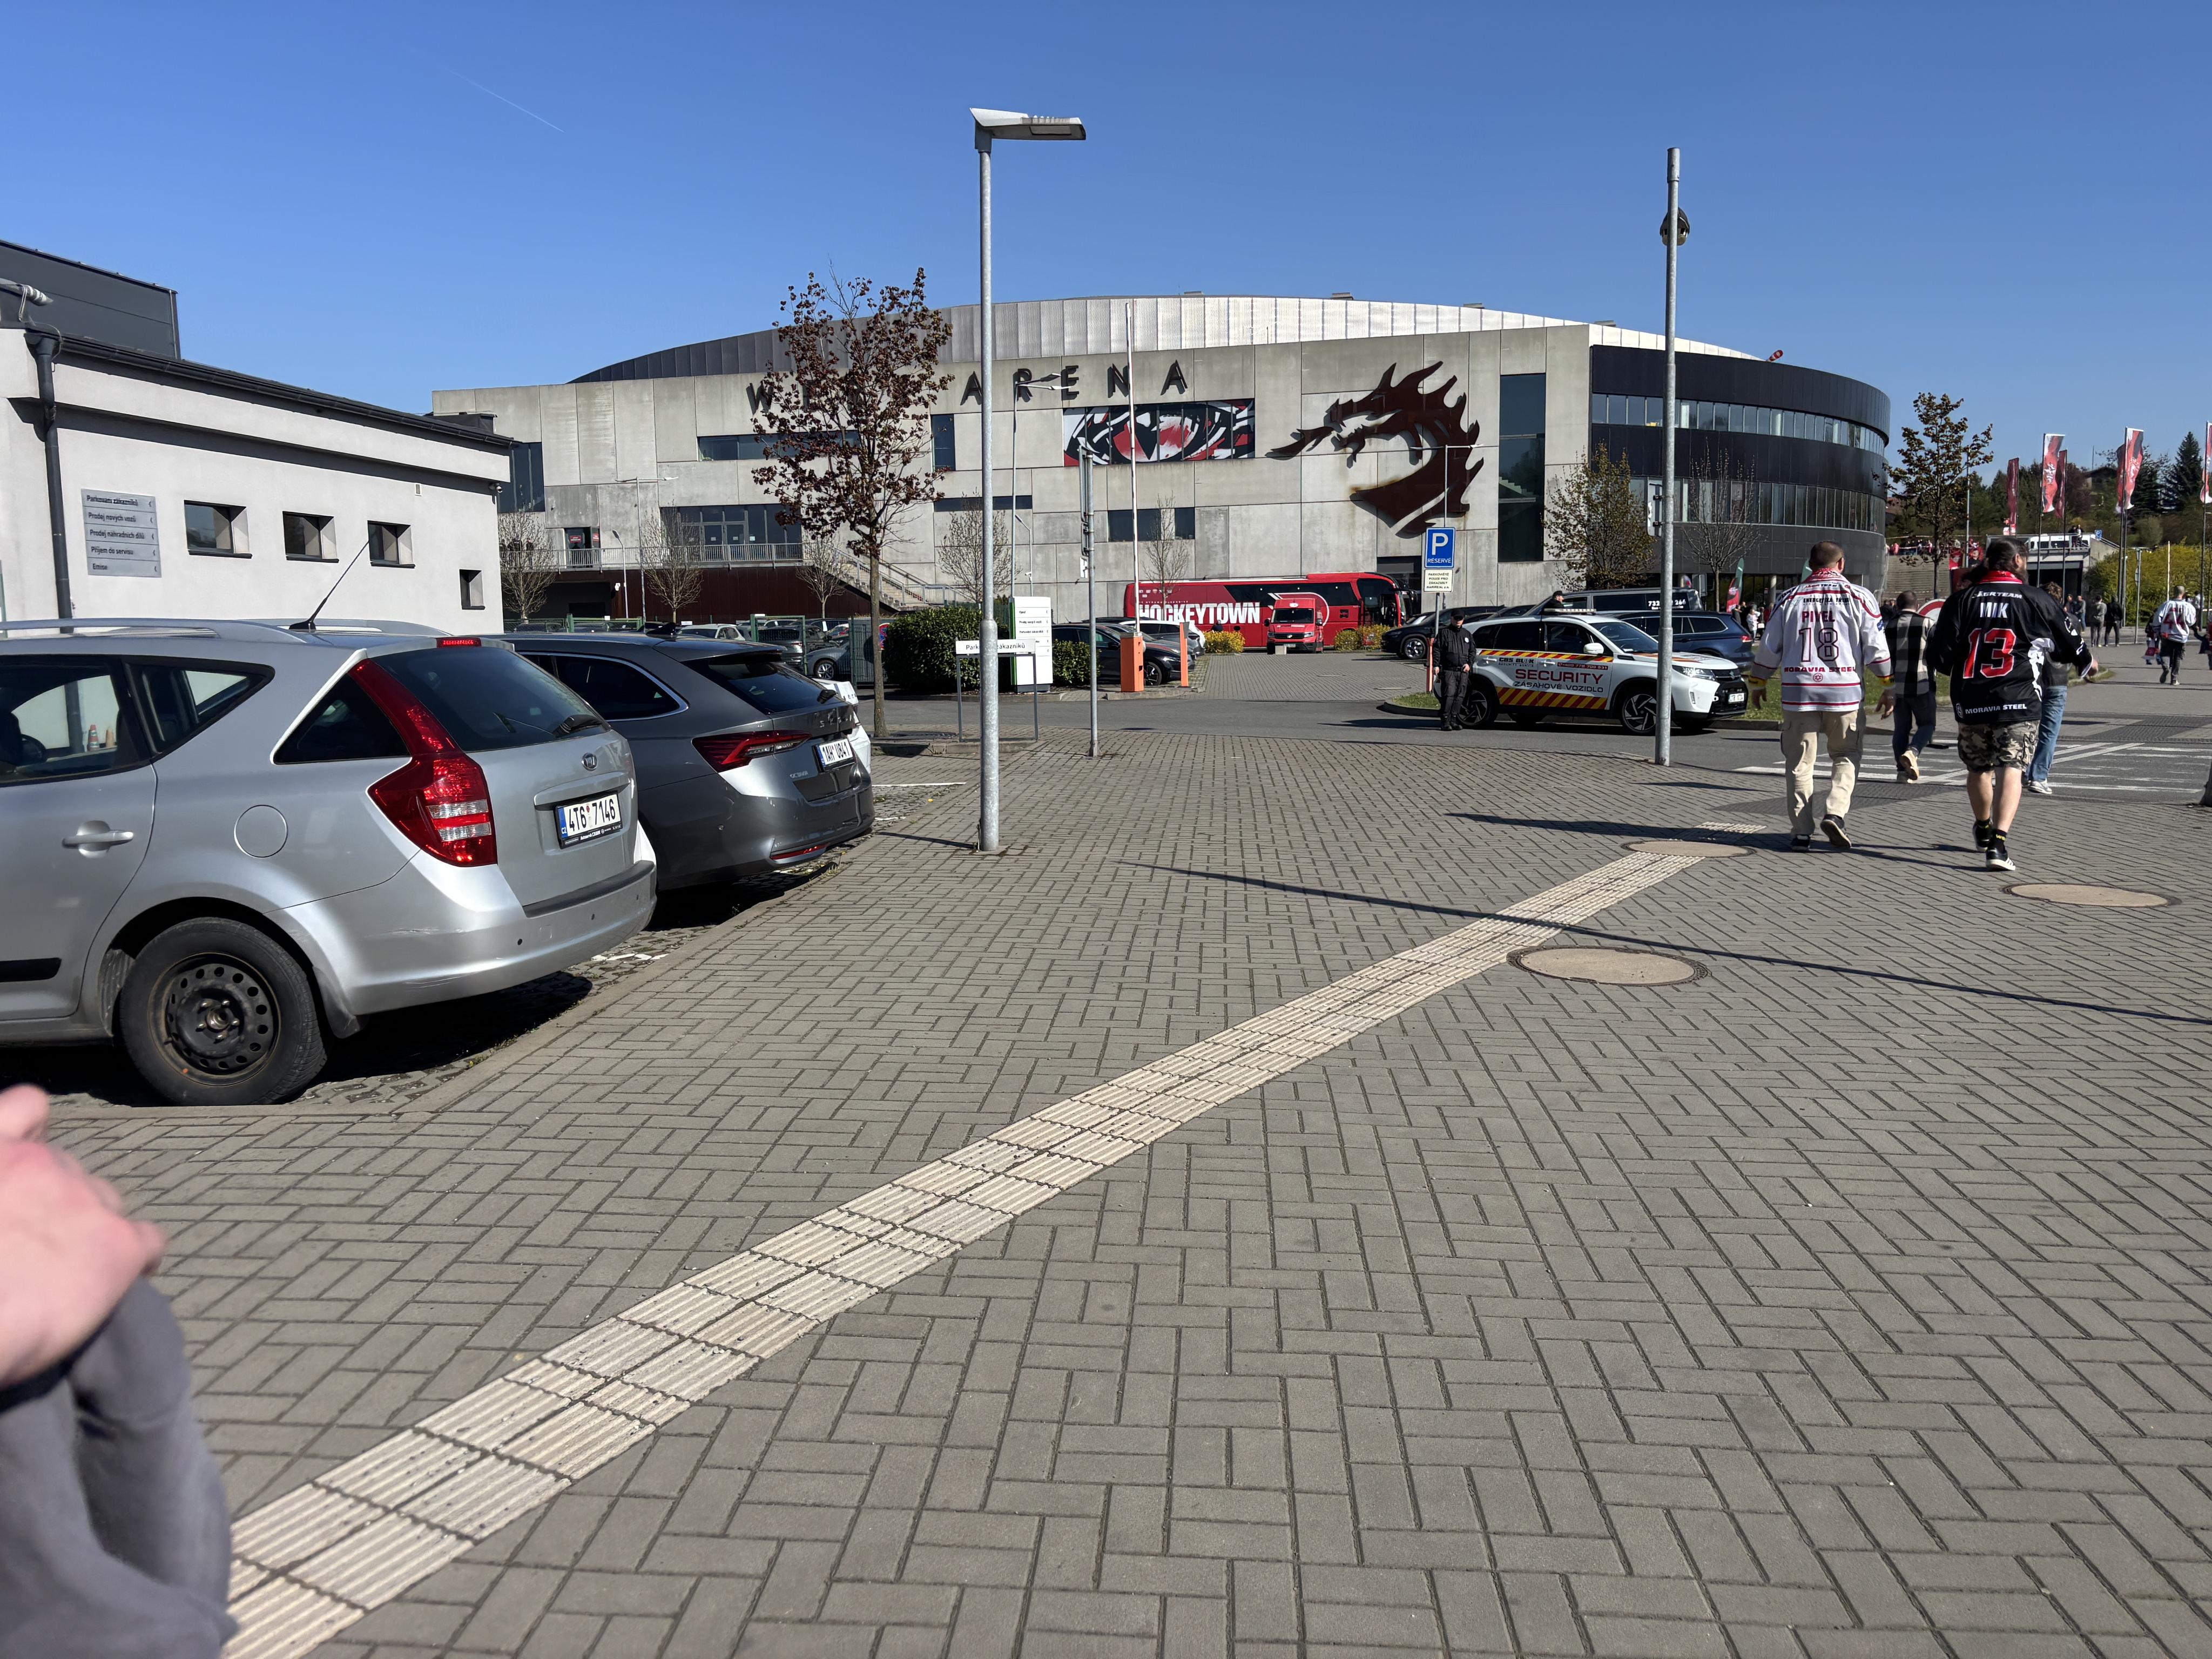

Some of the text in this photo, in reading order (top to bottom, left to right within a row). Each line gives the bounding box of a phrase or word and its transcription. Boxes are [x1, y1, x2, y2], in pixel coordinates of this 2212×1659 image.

[960, 360, 1188, 405] ARENA
[90, 529, 106, 538] Prodej
[1432, 532, 1448, 556] P
[1138, 602, 1260, 624] HOCKEYTOWN
[1980, 602, 2009, 618] MIK
[1799, 628, 1839, 663] 18
[1963, 628, 2016, 679] 13
[1514, 680, 1604, 693] ZÁSAHOVÉ VOZIDLO
[1515, 669, 1604, 685] SECURITY
[1965, 705, 2001, 714] MORAVIA
[569, 806, 587, 832] 4T6
[592, 798, 616, 825] 7146
